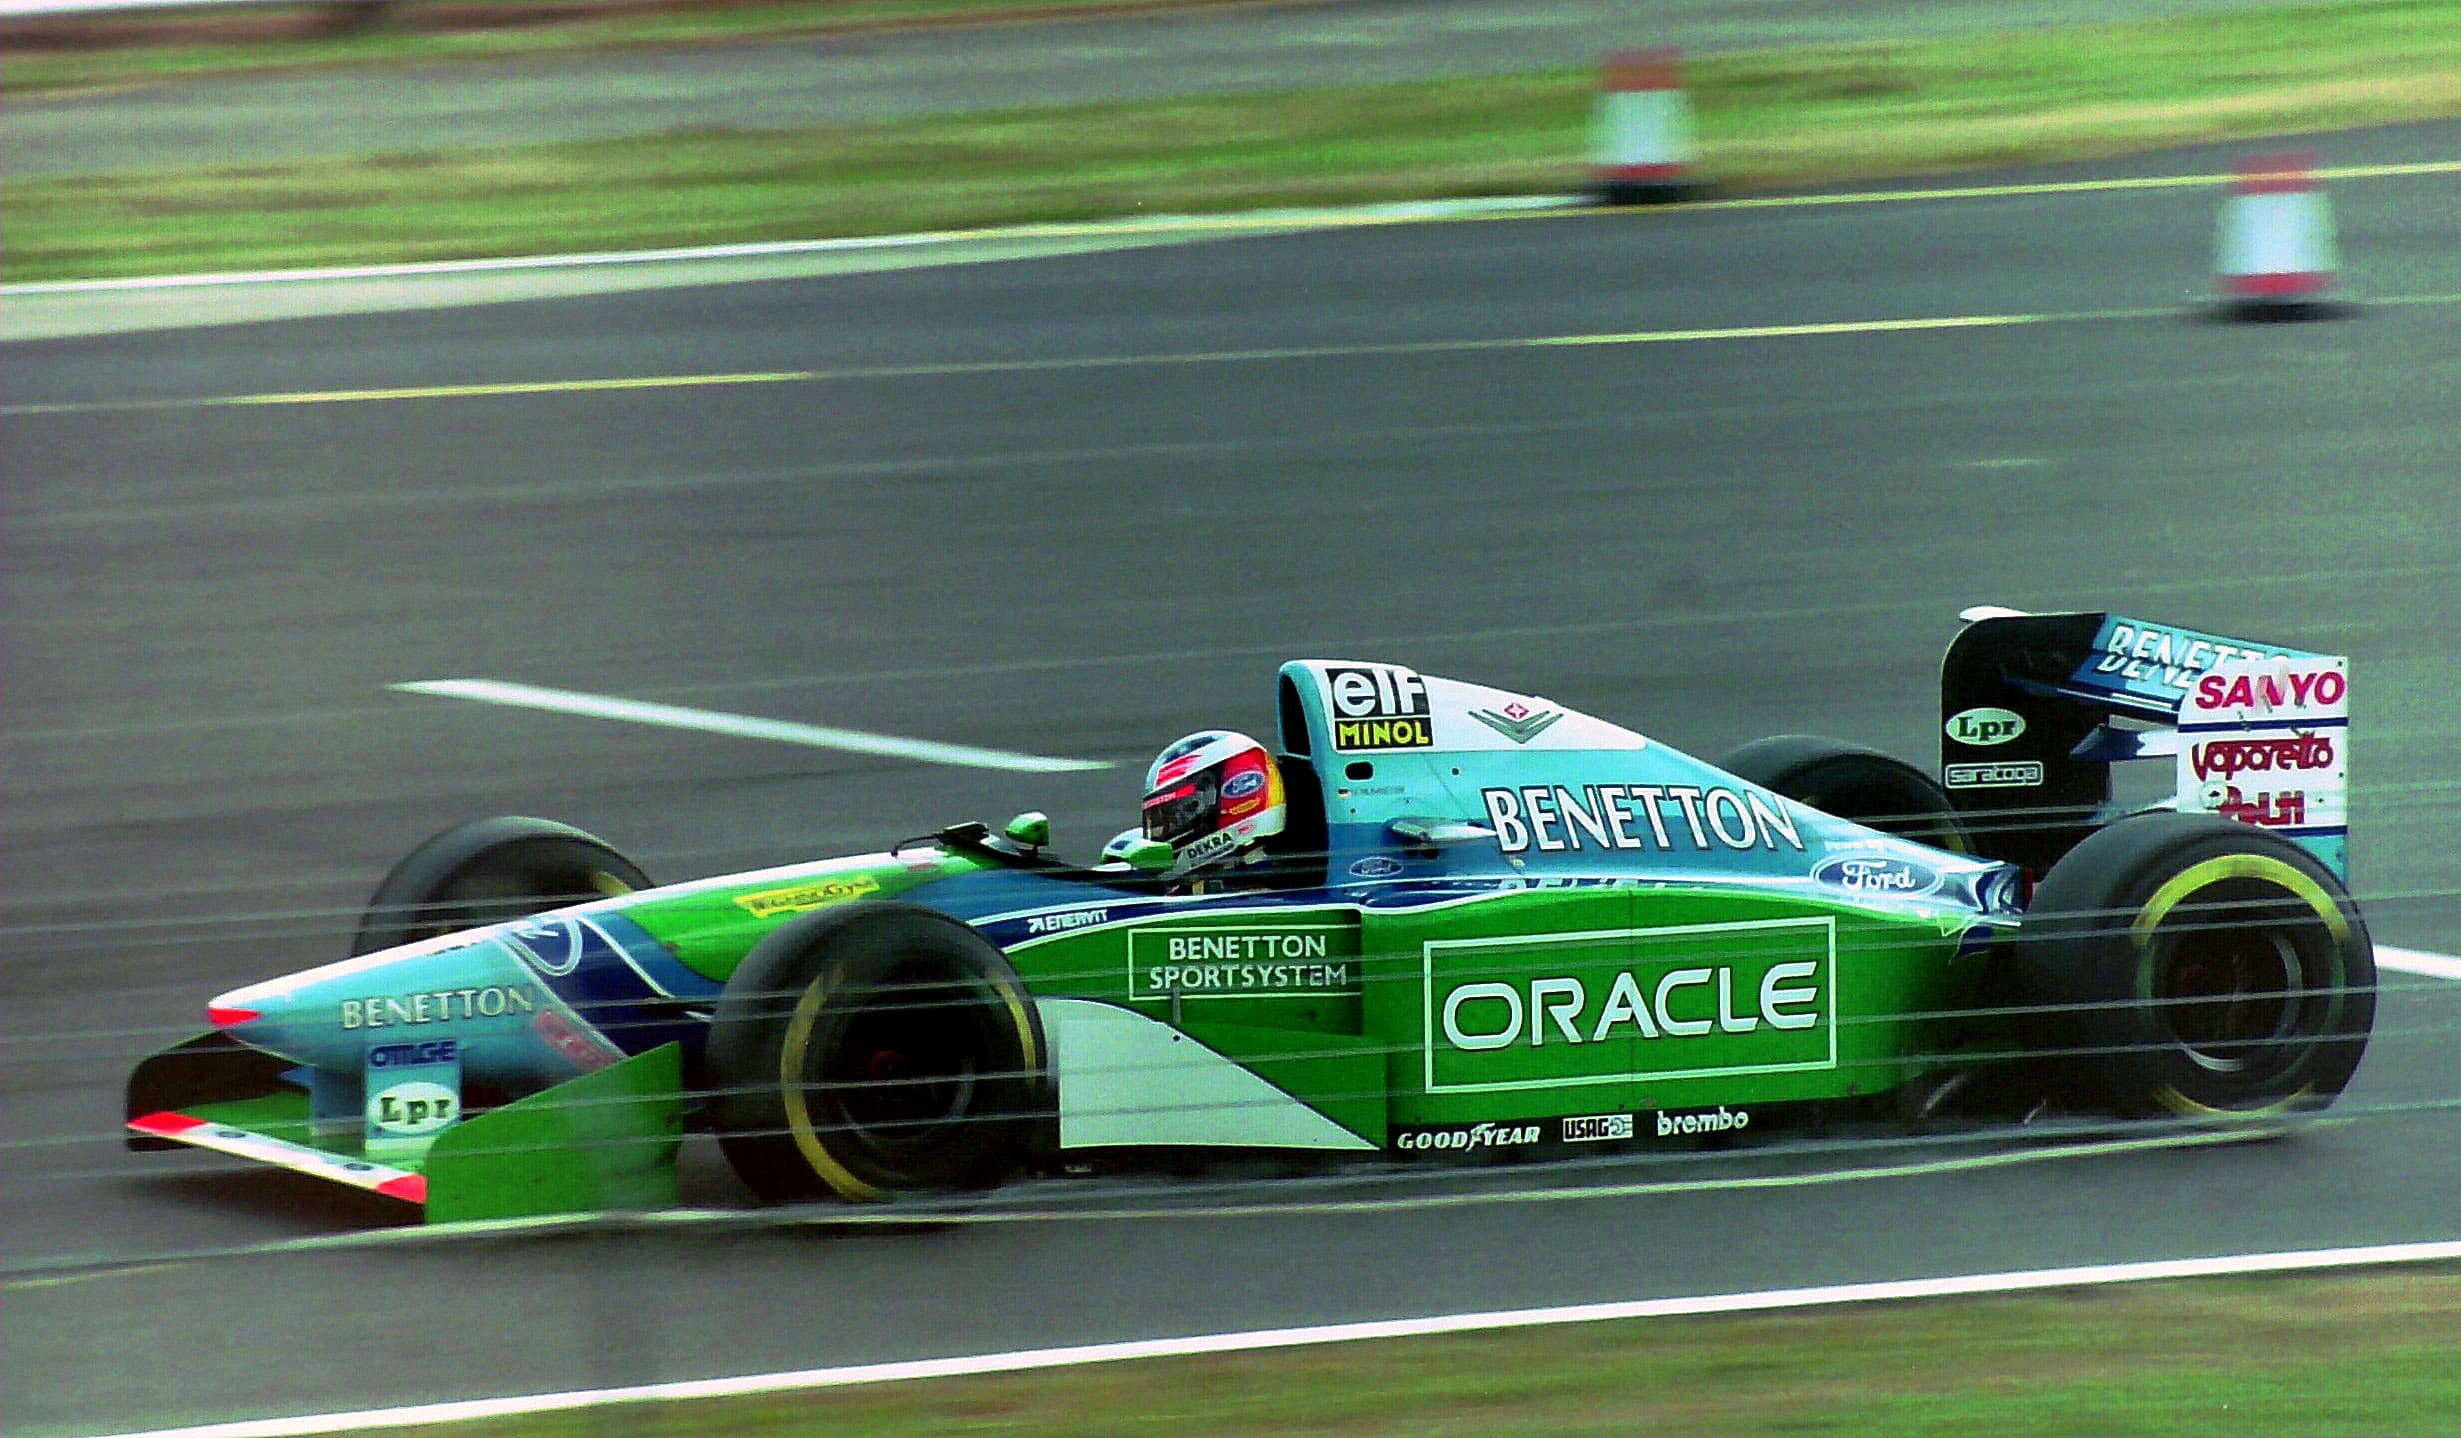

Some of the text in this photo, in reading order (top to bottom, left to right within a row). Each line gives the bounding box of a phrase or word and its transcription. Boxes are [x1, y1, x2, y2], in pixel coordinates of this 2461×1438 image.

[1334, 667, 1425, 716] elf
[2195, 671, 2347, 709] SANYO
[1339, 721, 1429, 746] MINOL
[1957, 716, 2017, 742] Lpr
[1481, 785, 1806, 852] BENETTON
[1187, 832, 1233, 859] DEKRA
[1842, 859, 1916, 890] Ford
[1168, 934, 1327, 961] BENETTON
[1149, 962, 1348, 991] SPORTSYSTEM
[341, 985, 533, 1030] BENETTON
[1442, 961, 1819, 1051] ORACLE
[380, 1096, 451, 1125] Lpr
[1657, 1105, 1750, 1137] brembo
[1564, 1116, 1610, 1141] USAG
